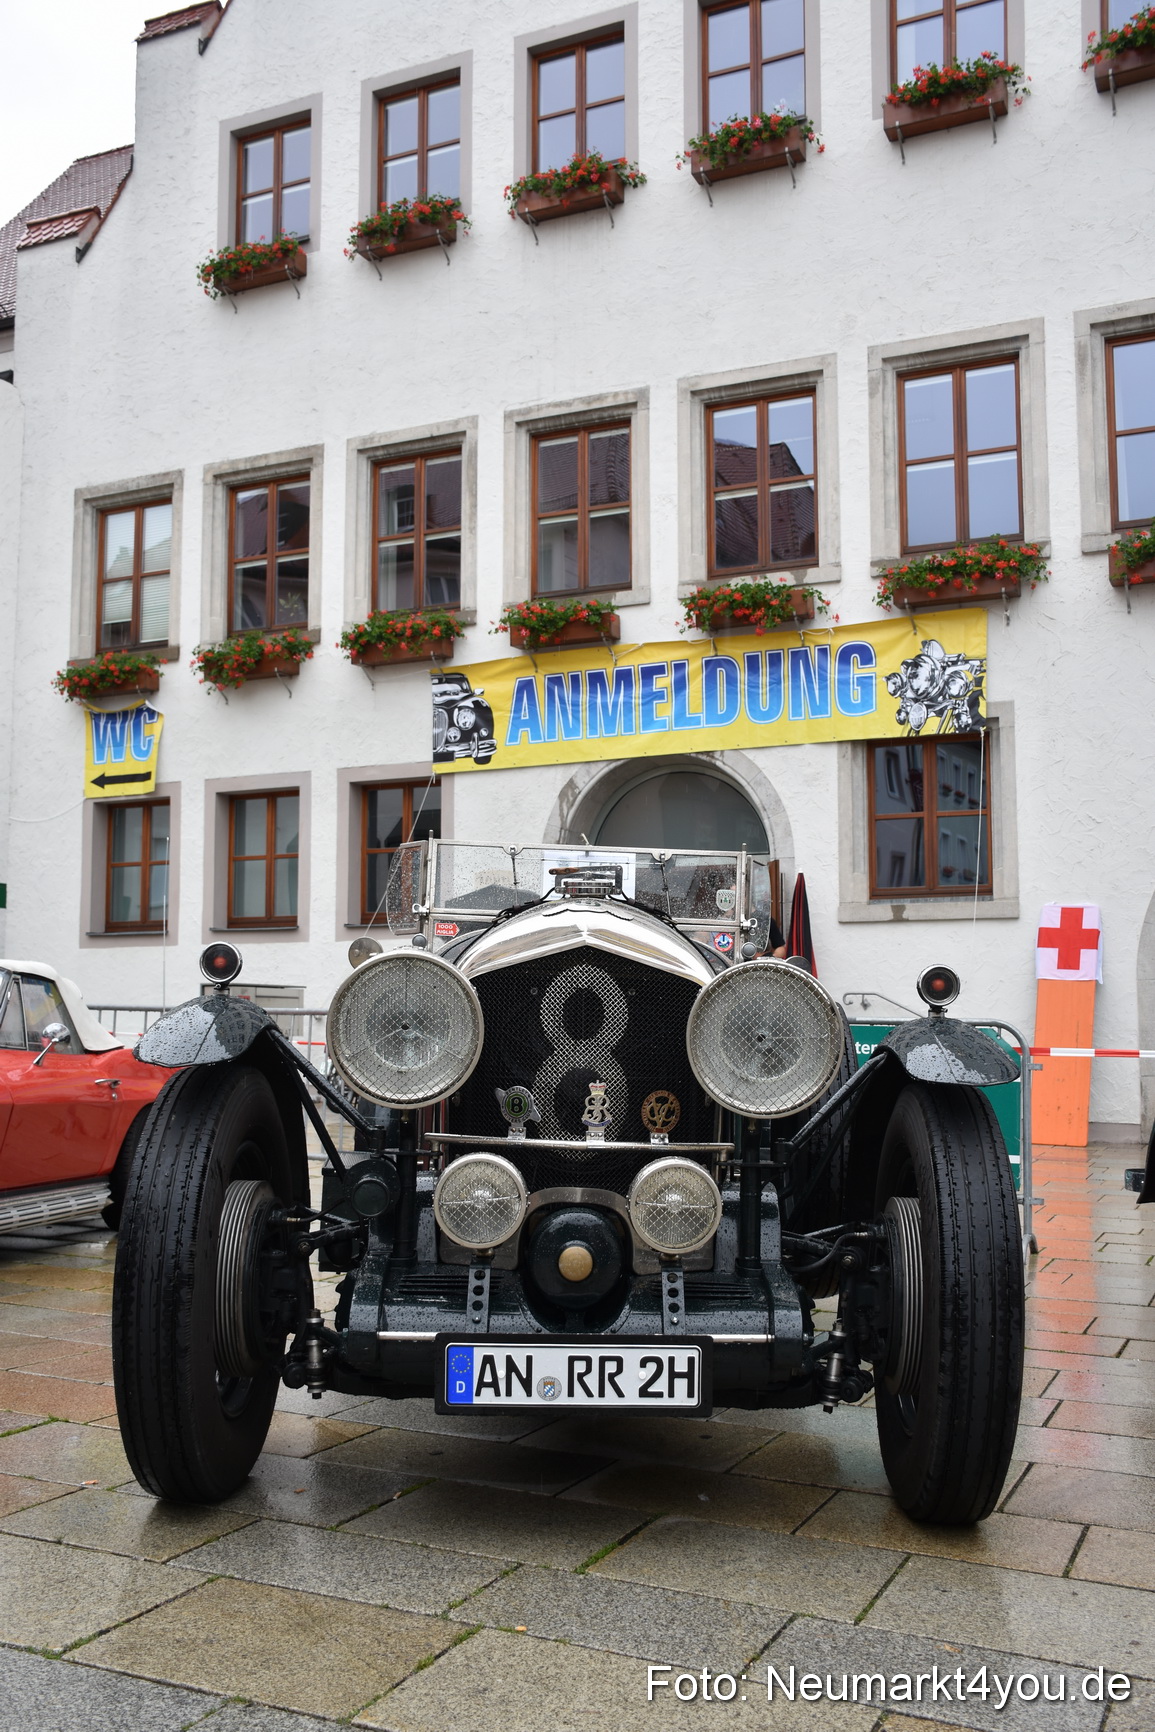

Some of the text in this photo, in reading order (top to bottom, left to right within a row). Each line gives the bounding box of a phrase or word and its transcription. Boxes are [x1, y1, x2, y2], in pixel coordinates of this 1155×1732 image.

[505, 640, 877, 746] ANMELDUNG
[91, 704, 158, 765] WC
[531, 962, 630, 1162] 8
[455, 1380, 466, 1394] D
[474, 1354, 533, 1397] AN
[567, 1355, 625, 1398] RR
[638, 1355, 696, 1398] 2H
